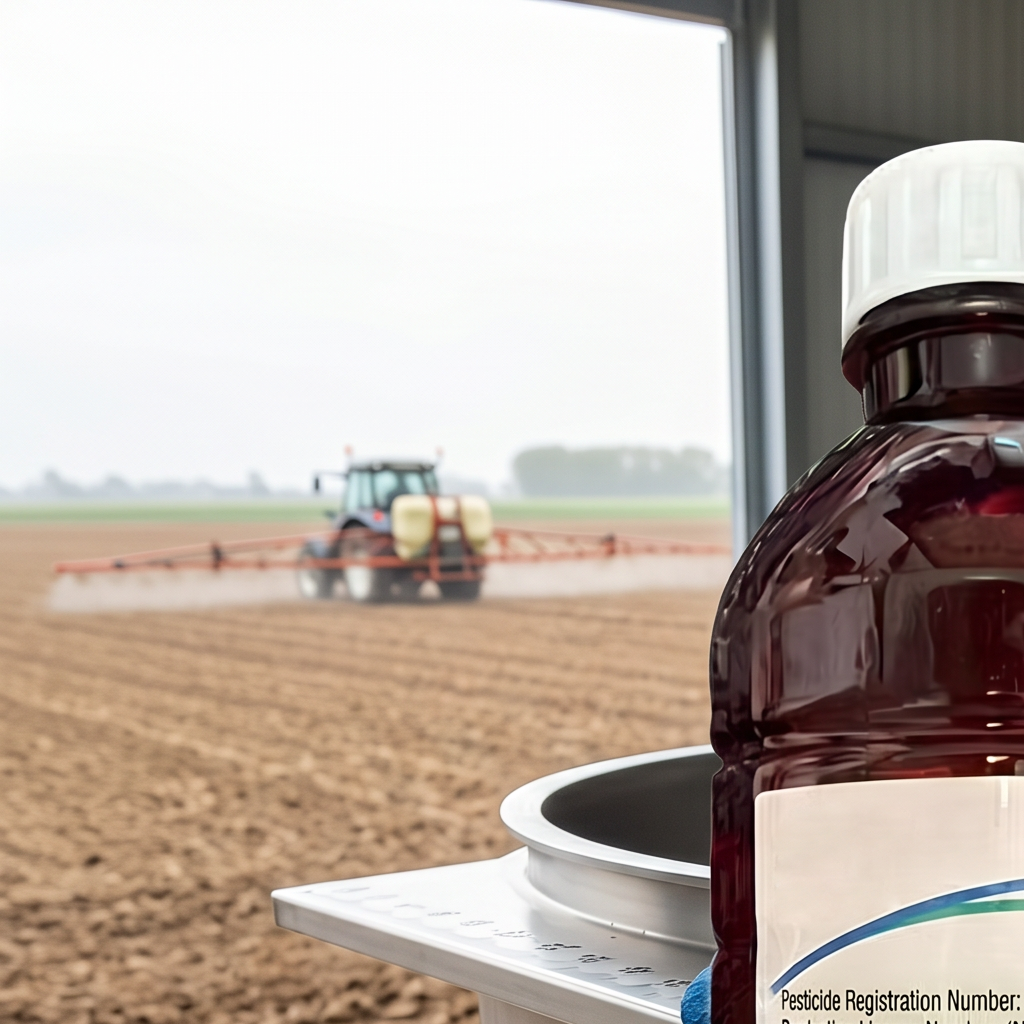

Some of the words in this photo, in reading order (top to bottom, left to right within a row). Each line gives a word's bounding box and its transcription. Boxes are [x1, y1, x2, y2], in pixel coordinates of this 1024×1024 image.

[781, 989, 841, 1011] Pesticide
[845, 989, 941, 1016] Registration
[947, 989, 1021, 1011] Number:
